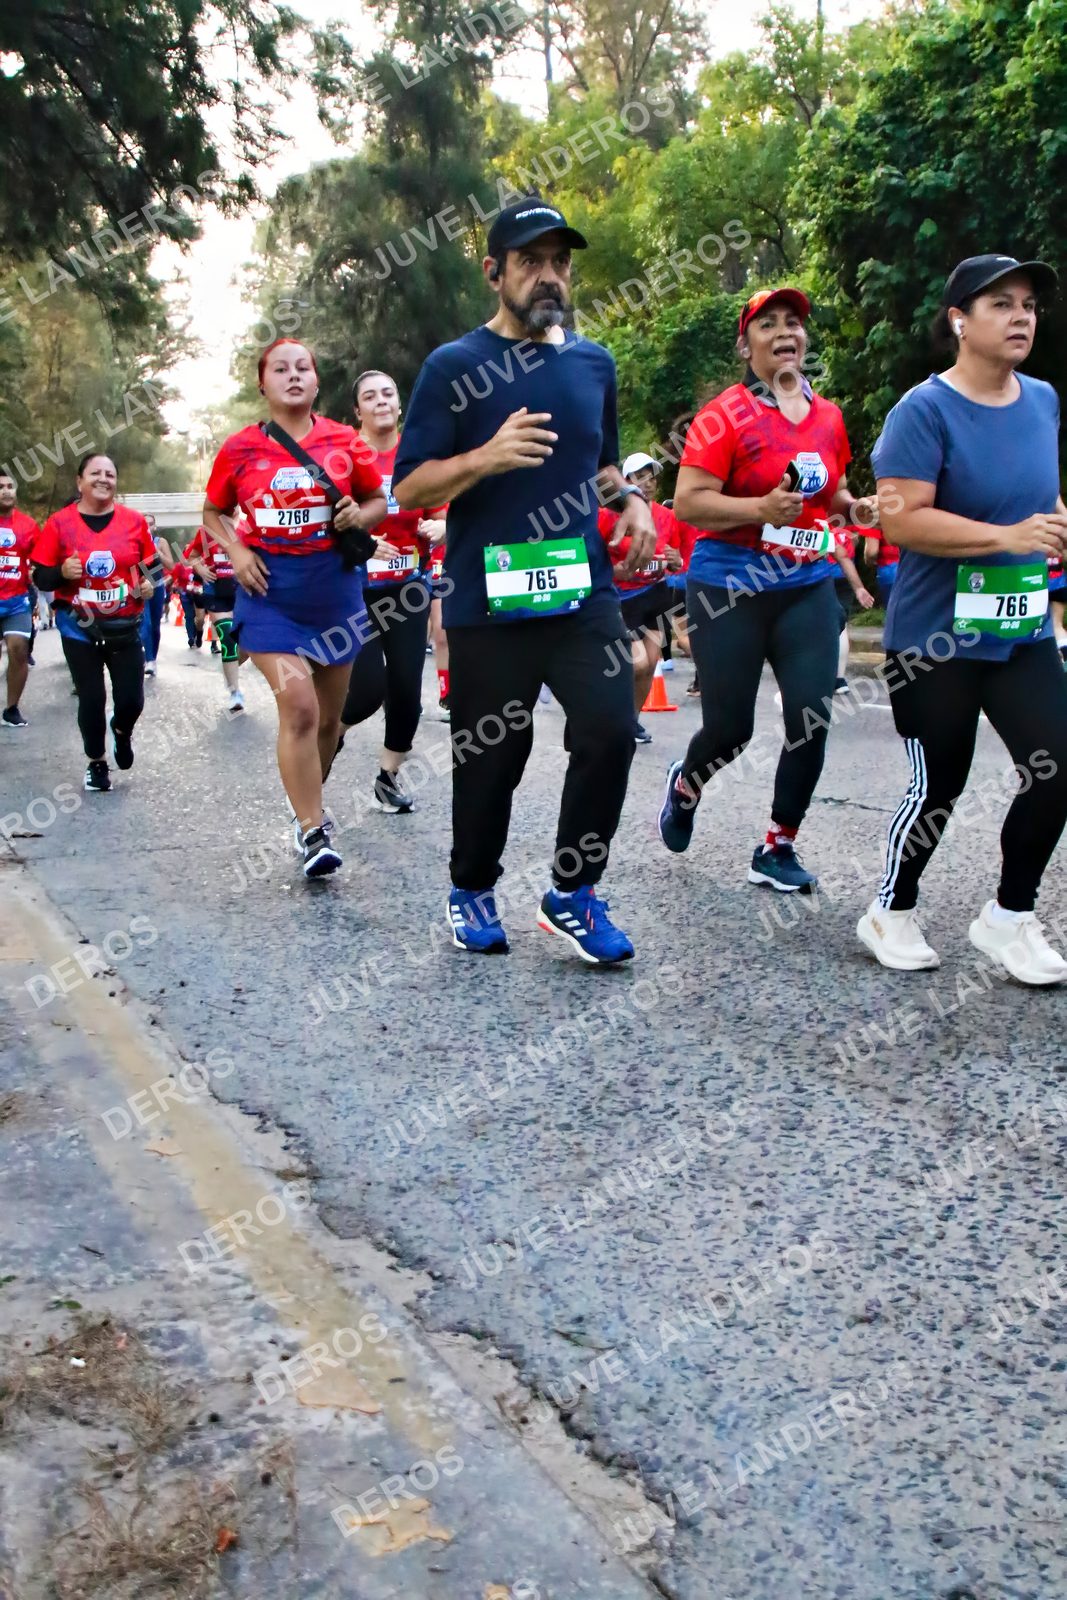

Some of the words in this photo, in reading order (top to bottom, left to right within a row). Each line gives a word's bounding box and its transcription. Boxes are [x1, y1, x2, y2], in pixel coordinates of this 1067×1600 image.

[278, 509, 310, 526] 2768
[790, 529, 818, 549] 1891
[388, 556, 408, 570] 3571
[525, 568, 558, 592] 765
[96, 590, 116, 601] 1671
[996, 594, 1028, 617] 766
